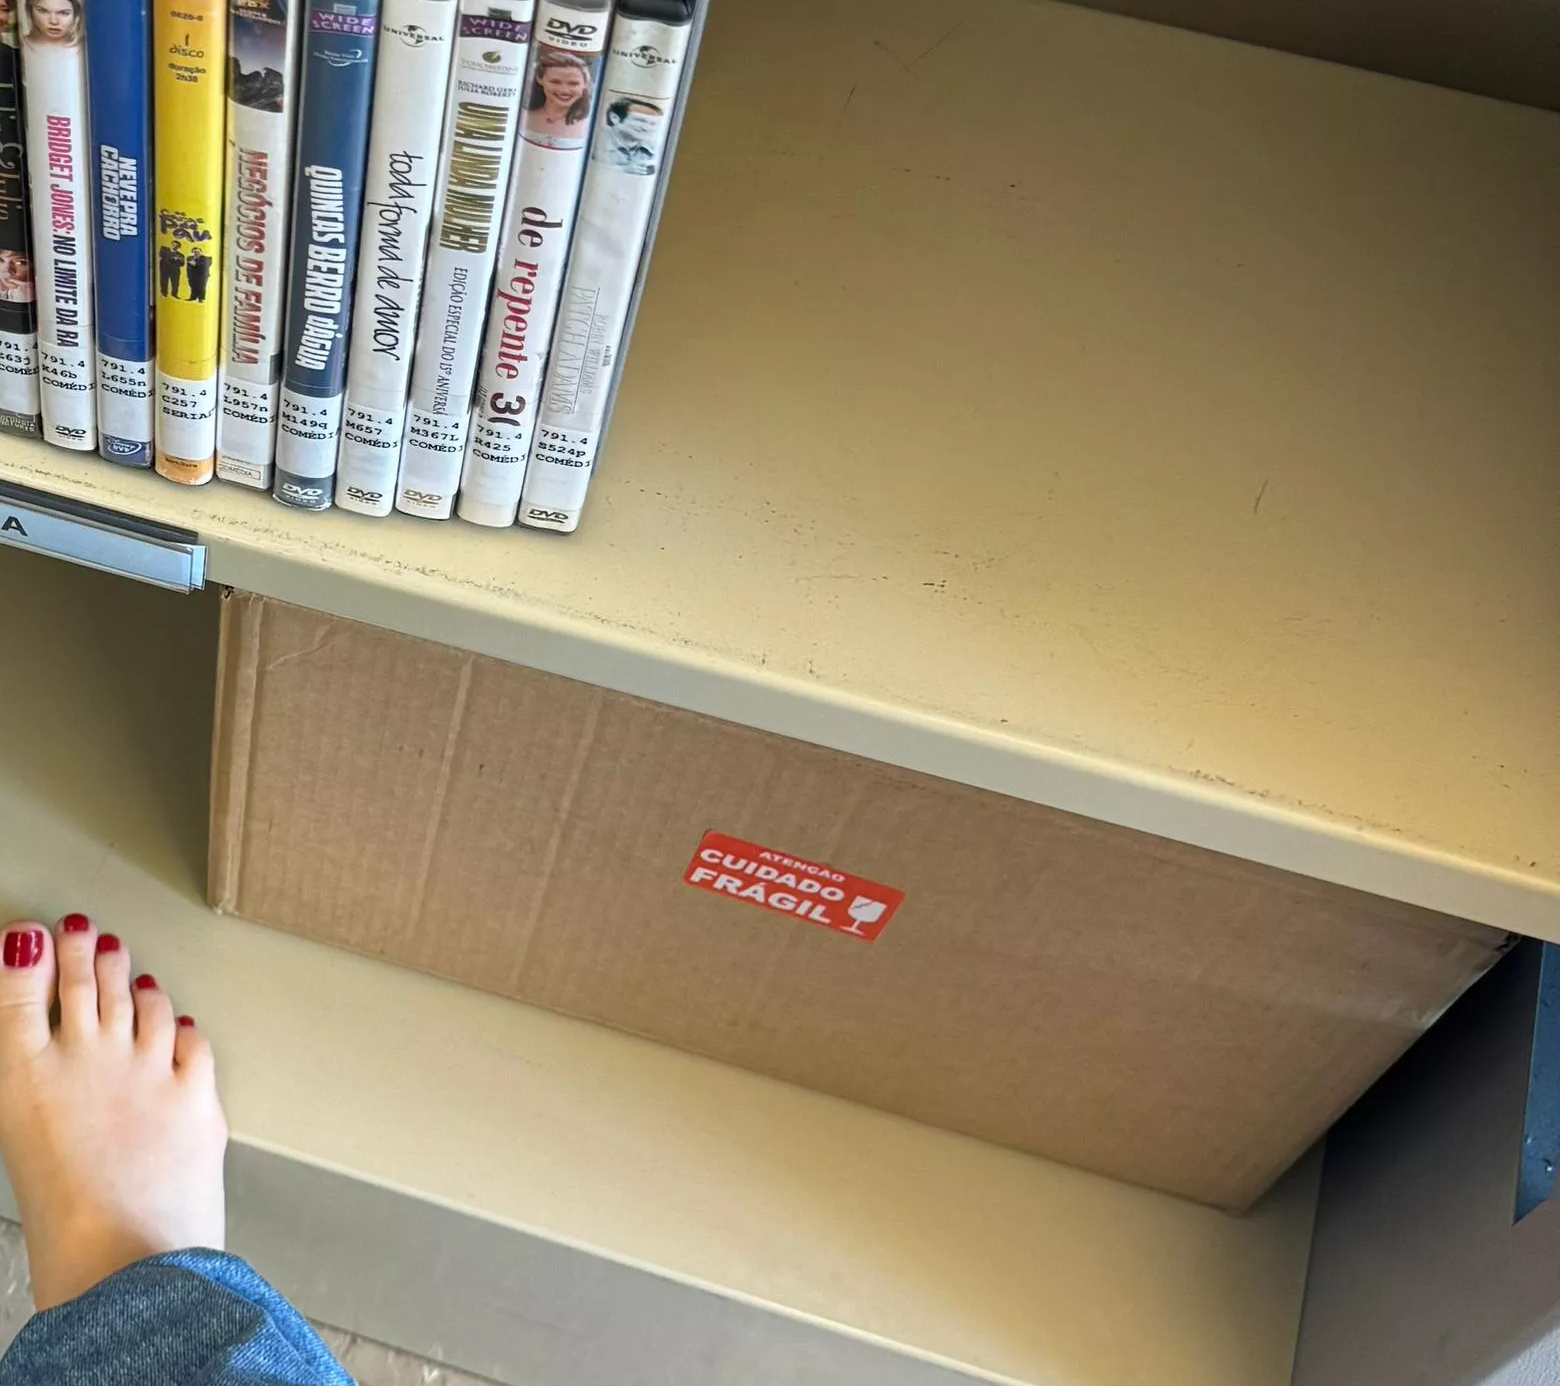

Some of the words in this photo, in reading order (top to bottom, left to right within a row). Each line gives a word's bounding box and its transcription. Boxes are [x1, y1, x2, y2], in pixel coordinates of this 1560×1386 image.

[168, 44, 205, 59] disco
[383, 25, 445, 42] UNIVERSAL
[167, 62, 207, 75] duração
[611, 48, 678, 66] UNIVERSAL
[454, 101, 509, 141] UMA
[46, 115, 74, 182] BRIDGET
[448, 140, 503, 190] LINDA
[100, 144, 121, 242] CACHORRO
[389, 150, 427, 199] toda
[49, 183, 76, 234] JONES:
[235, 147, 273, 255] NEGÓCIOS
[304, 164, 345, 243] QUINCAS
[439, 188, 496, 254] MULHER
[52, 234, 76, 257] NO
[367, 200, 417, 262] forma
[517, 206, 564, 249] de
[53, 259, 79, 307] LIMITE
[236, 255, 265, 287] DE
[303, 244, 347, 314] BERRO
[377, 264, 414, 290] de
[56, 306, 80, 329] DA
[232, 285, 267, 364] FAMÍLIA
[372, 293, 405, 361] amor
[495, 256, 540, 381] repente
[40, 351, 86, 369] 791.4
[162, 382, 207, 397] 791.4
[162, 395, 197, 408] C257
[345, 419, 383, 436] M657
[347, 407, 393, 425] 791.4
[412, 414, 460, 430] 791.4
[476, 424, 523, 440] 791.4
[474, 436, 512, 452] R425
[540, 429, 589, 445] 791.4
[699, 848, 846, 902] CUIDADO
[689, 866, 832, 925] FRÁGIL
